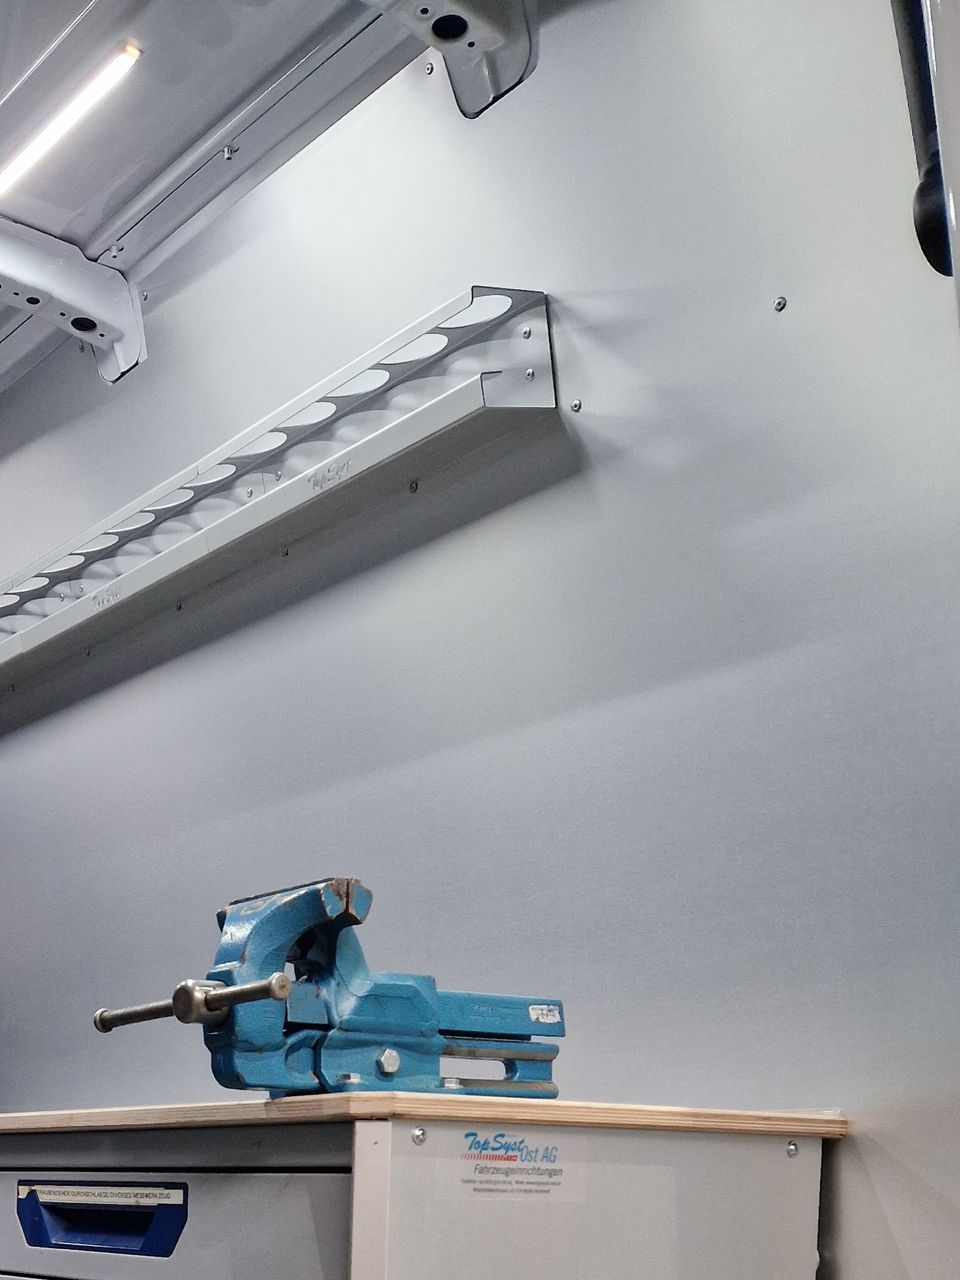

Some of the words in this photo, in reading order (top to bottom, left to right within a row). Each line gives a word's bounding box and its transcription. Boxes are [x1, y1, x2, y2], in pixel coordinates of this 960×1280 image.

[520, 1145, 538, 1163] Ost
[541, 1146, 559, 1163] AG
[473, 1163, 564, 1178] Fahrzeugeinrichtungen
